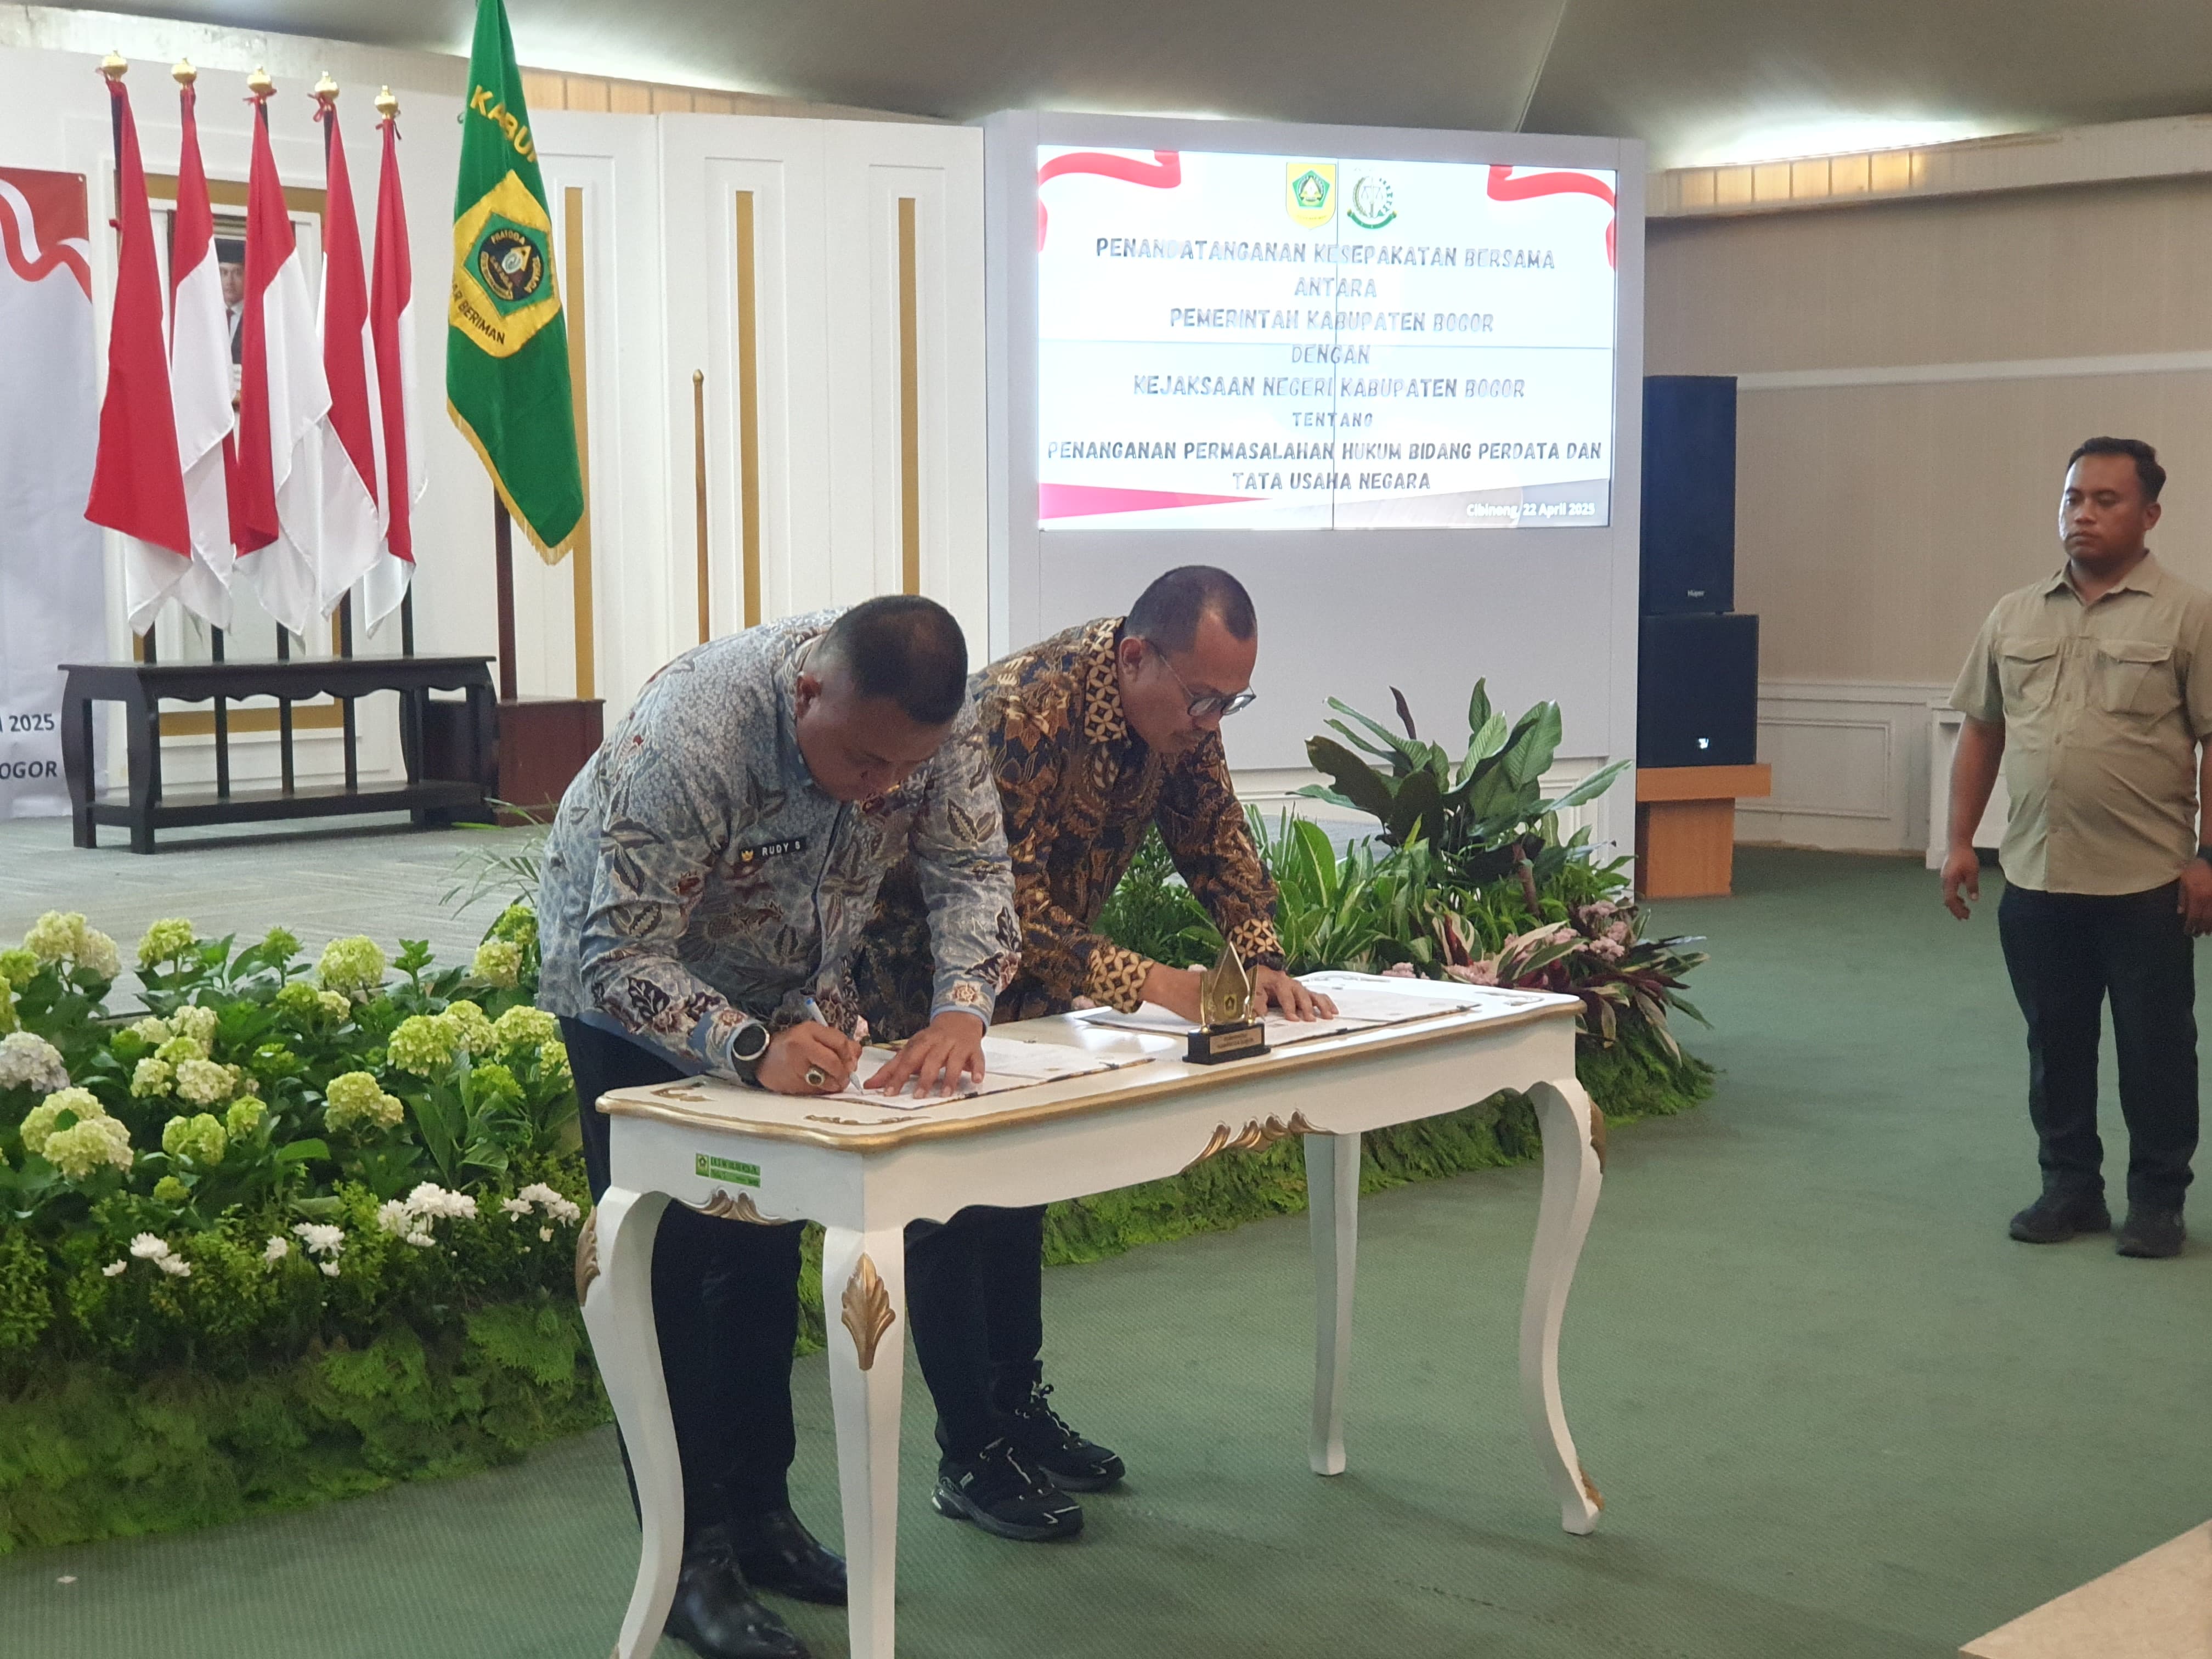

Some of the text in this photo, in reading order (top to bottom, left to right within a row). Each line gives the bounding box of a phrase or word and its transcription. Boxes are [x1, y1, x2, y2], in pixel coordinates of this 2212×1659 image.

[470, 84, 538, 163] KABU
[1097, 238, 1555, 269] PENANDATANGANAN KESEPAKATAN BERSAMA
[1294, 276, 1377, 297] ANTARA
[458, 300, 505, 345] BERIMAN
[1170, 308, 1494, 332] PEMERINTAH KABUPATEN BOGOR
[1291, 343, 1371, 364] DENGAN
[1133, 375, 1525, 398] KEJAKSAAN NEGERI KABUPATEN BOGOR
[1292, 412, 1373, 427] TENTANG
[1048, 441, 1601, 460] PENANGANAN PERMASALAHAN HUKUM BIDANG PERDATA DAN
[1232, 472, 1431, 490] TATA USAHA NEGARA
[1522, 503, 1537, 516] 22
[1538, 502, 1567, 519] April
[1568, 502, 1595, 516] 2025
[8, 713, 55, 732] 2025
[762, 843, 789, 856] RUDY
